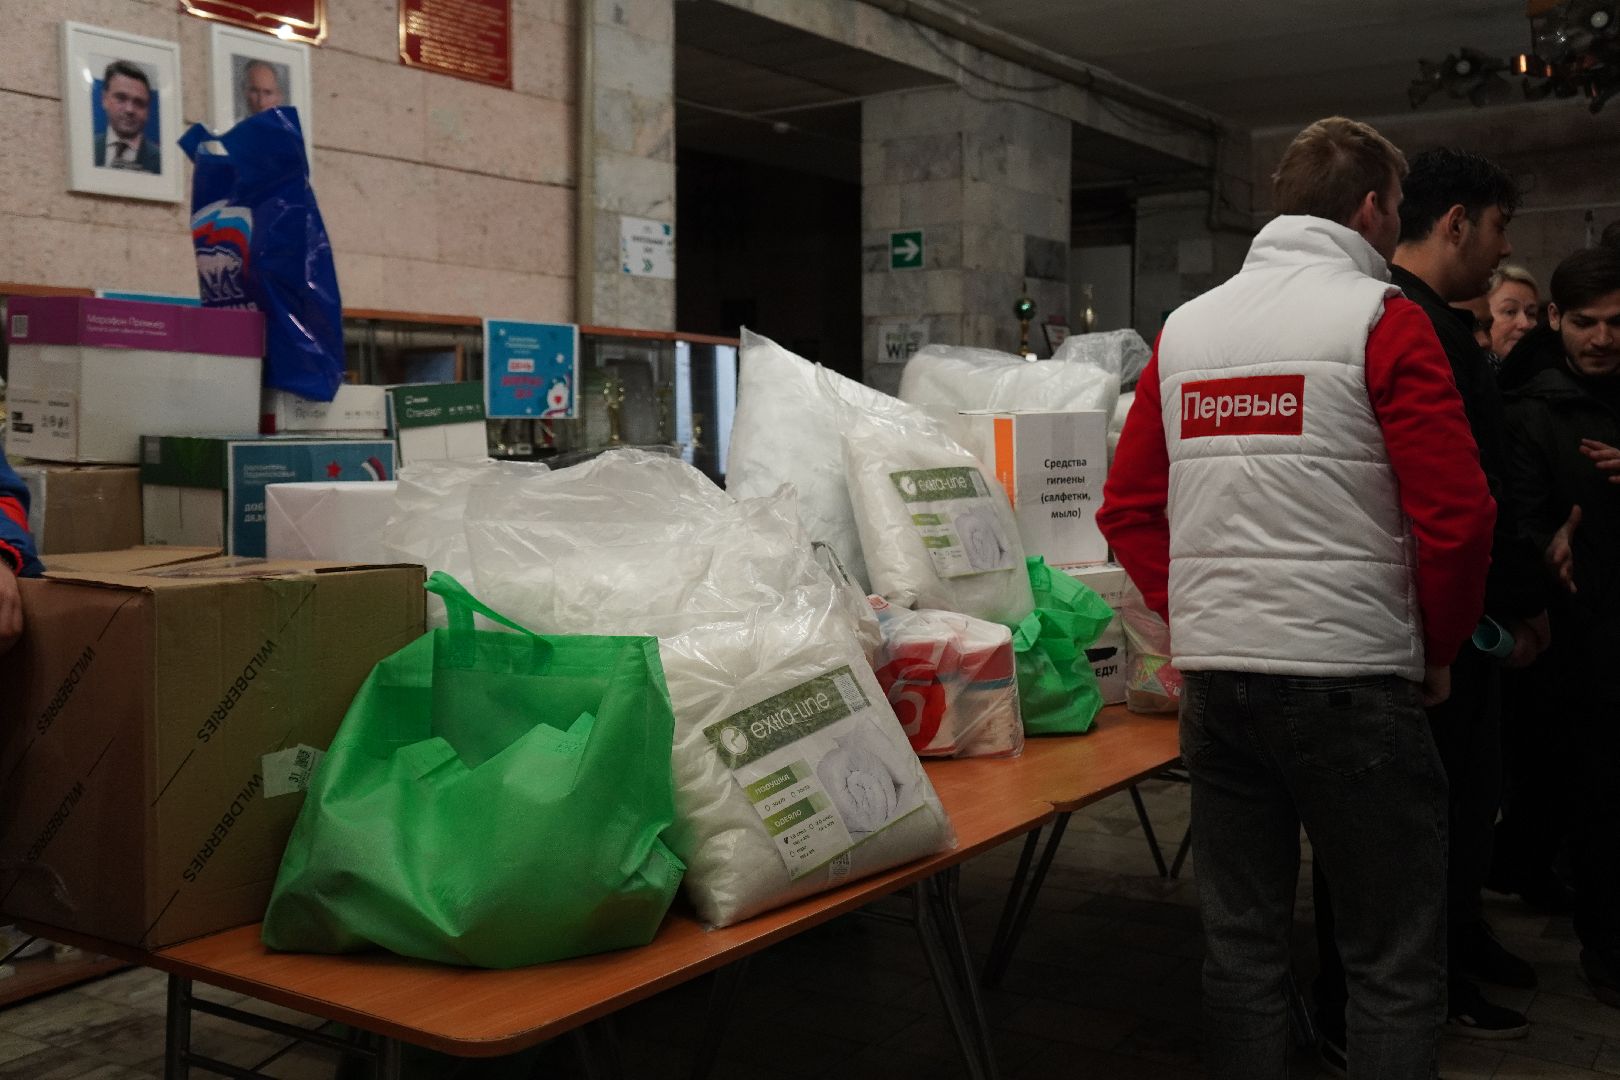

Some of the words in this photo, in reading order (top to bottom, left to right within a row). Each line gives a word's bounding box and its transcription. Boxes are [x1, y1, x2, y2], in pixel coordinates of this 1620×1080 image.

[1184, 392, 1298, 427] Первые
[1044, 459, 1087, 470] Средства
[1046, 476, 1085, 485] гигиены
[1041, 492, 1091, 504] (салфетки,
[1051, 507, 1082, 519] мыло)
[36, 646, 96, 735] WILDBERRIES
[196, 639, 278, 743] WILDBERRIES
[183, 773, 264, 882] WILDBERRIES
[774, 808, 802, 828] ОДЕЯЛО
